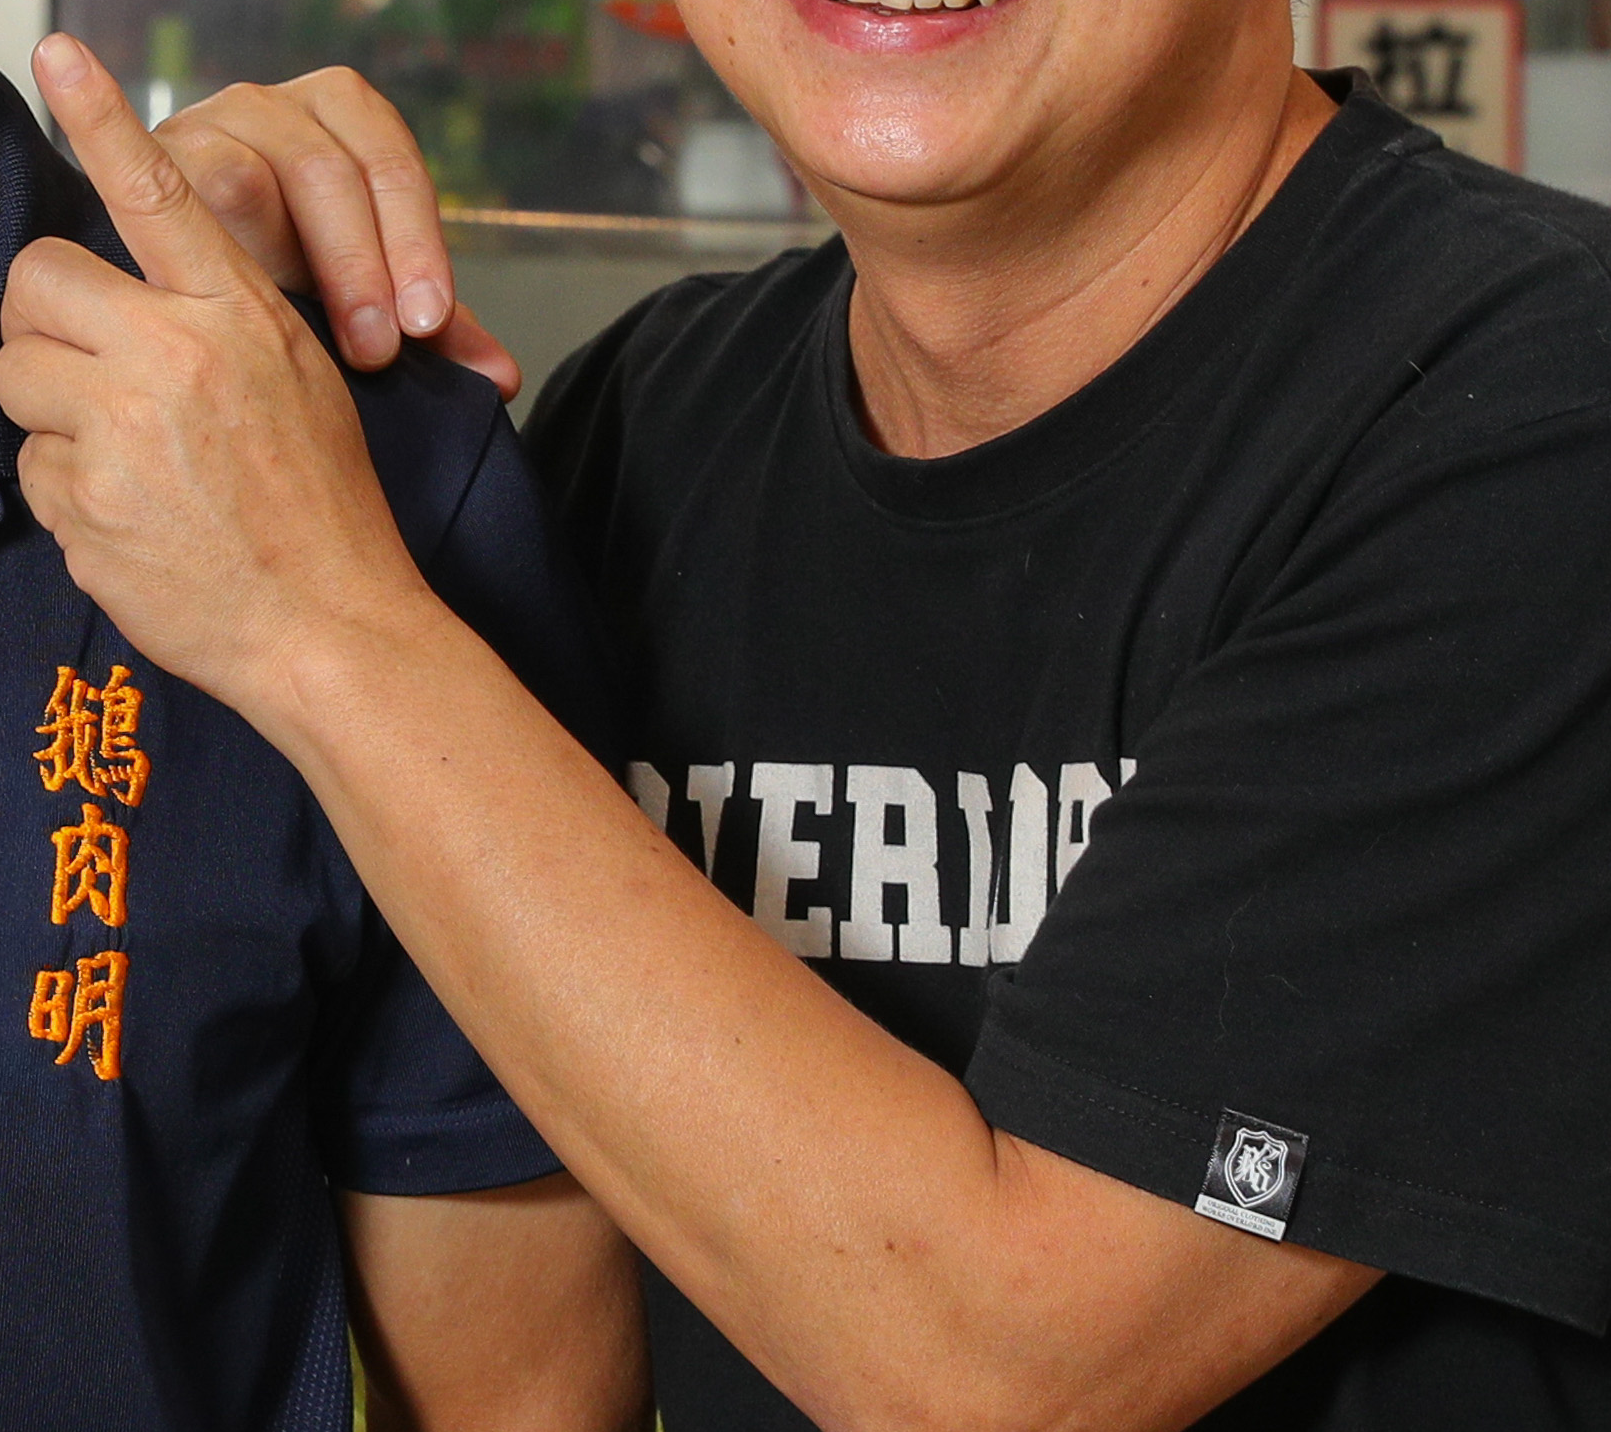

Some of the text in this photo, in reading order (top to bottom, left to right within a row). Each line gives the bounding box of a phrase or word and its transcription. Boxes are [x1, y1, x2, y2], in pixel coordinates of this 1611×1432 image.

[1366, 22, 1476, 117] 拉
[28, 664, 152, 1081] 鵝肉明
